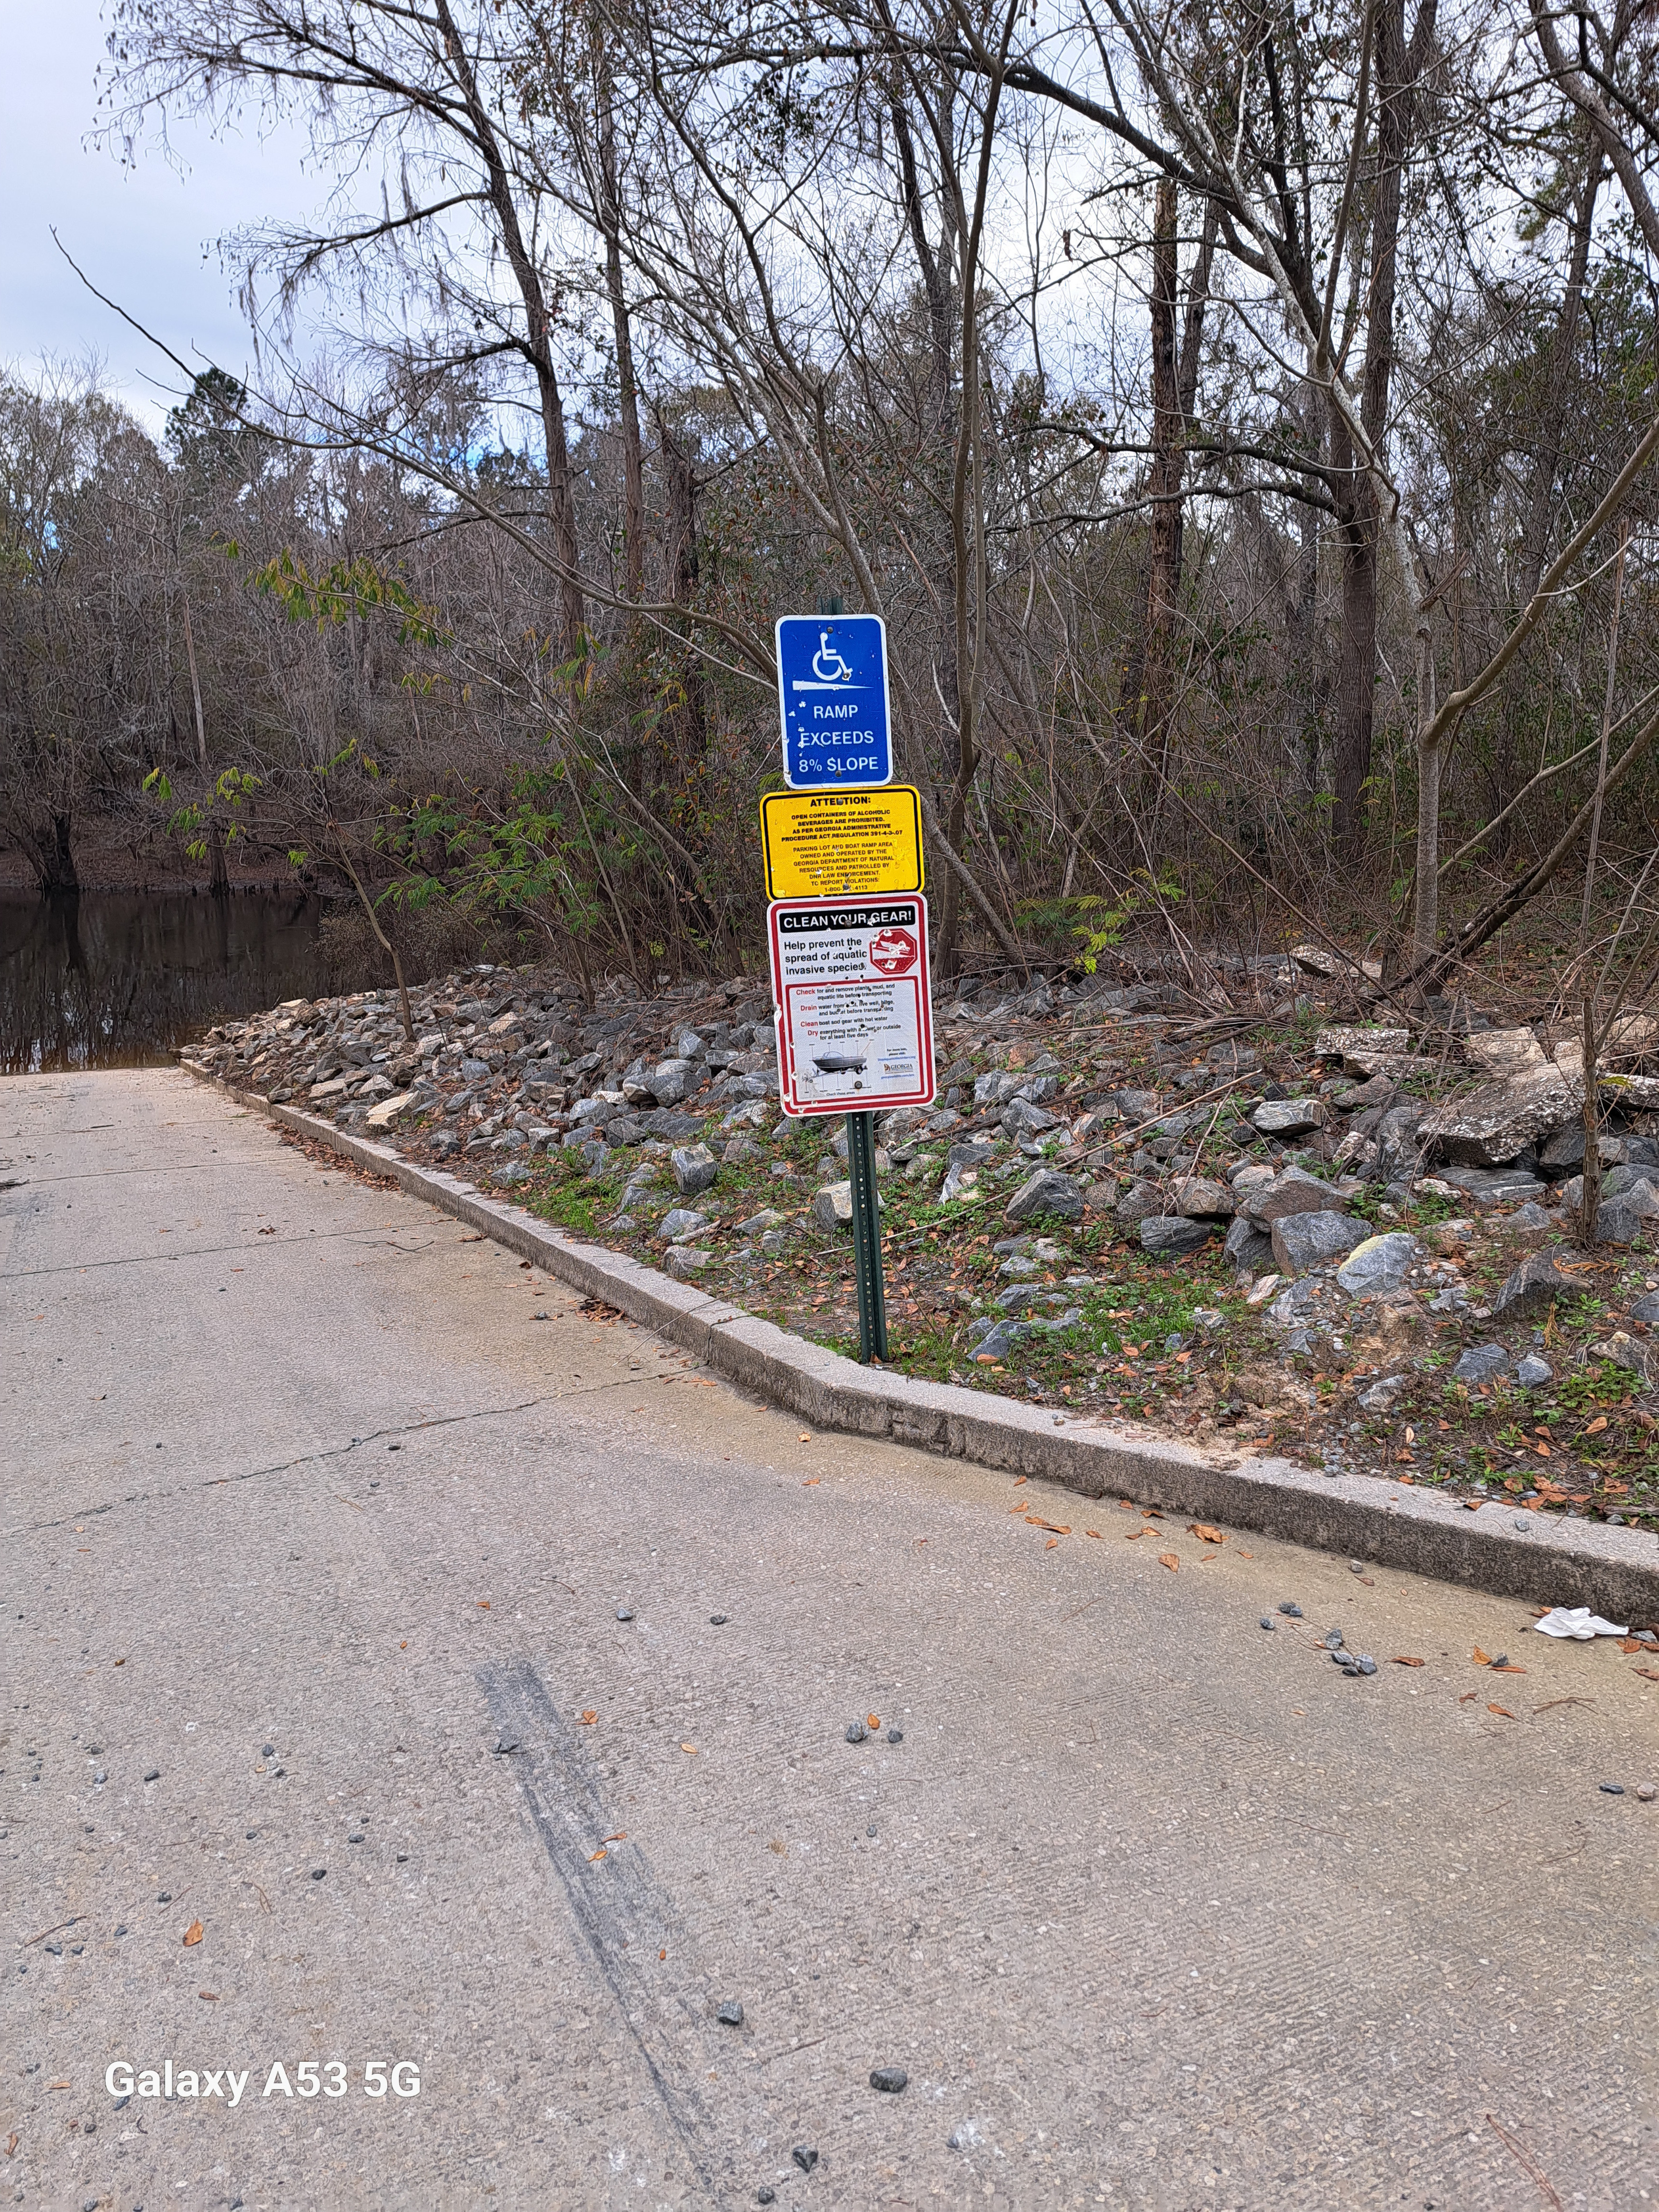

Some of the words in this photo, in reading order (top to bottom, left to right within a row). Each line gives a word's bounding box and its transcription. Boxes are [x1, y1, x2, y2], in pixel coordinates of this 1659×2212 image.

[814, 705, 858, 719] RAMP
[801, 730, 874, 746] EXCEEDS
[799, 759, 822, 772] 8%
[827, 757, 878, 771] SLOPE
[784, 916, 828, 928] CLEAN
[830, 914, 867, 925] YOUR
[871, 911, 911, 923] GEAR!
[784, 941, 806, 950] Help
[809, 940, 844, 951] prevent
[785, 952, 818, 964] spread
[833, 949, 867, 961] aquatic
[786, 965, 825, 975] invasive
